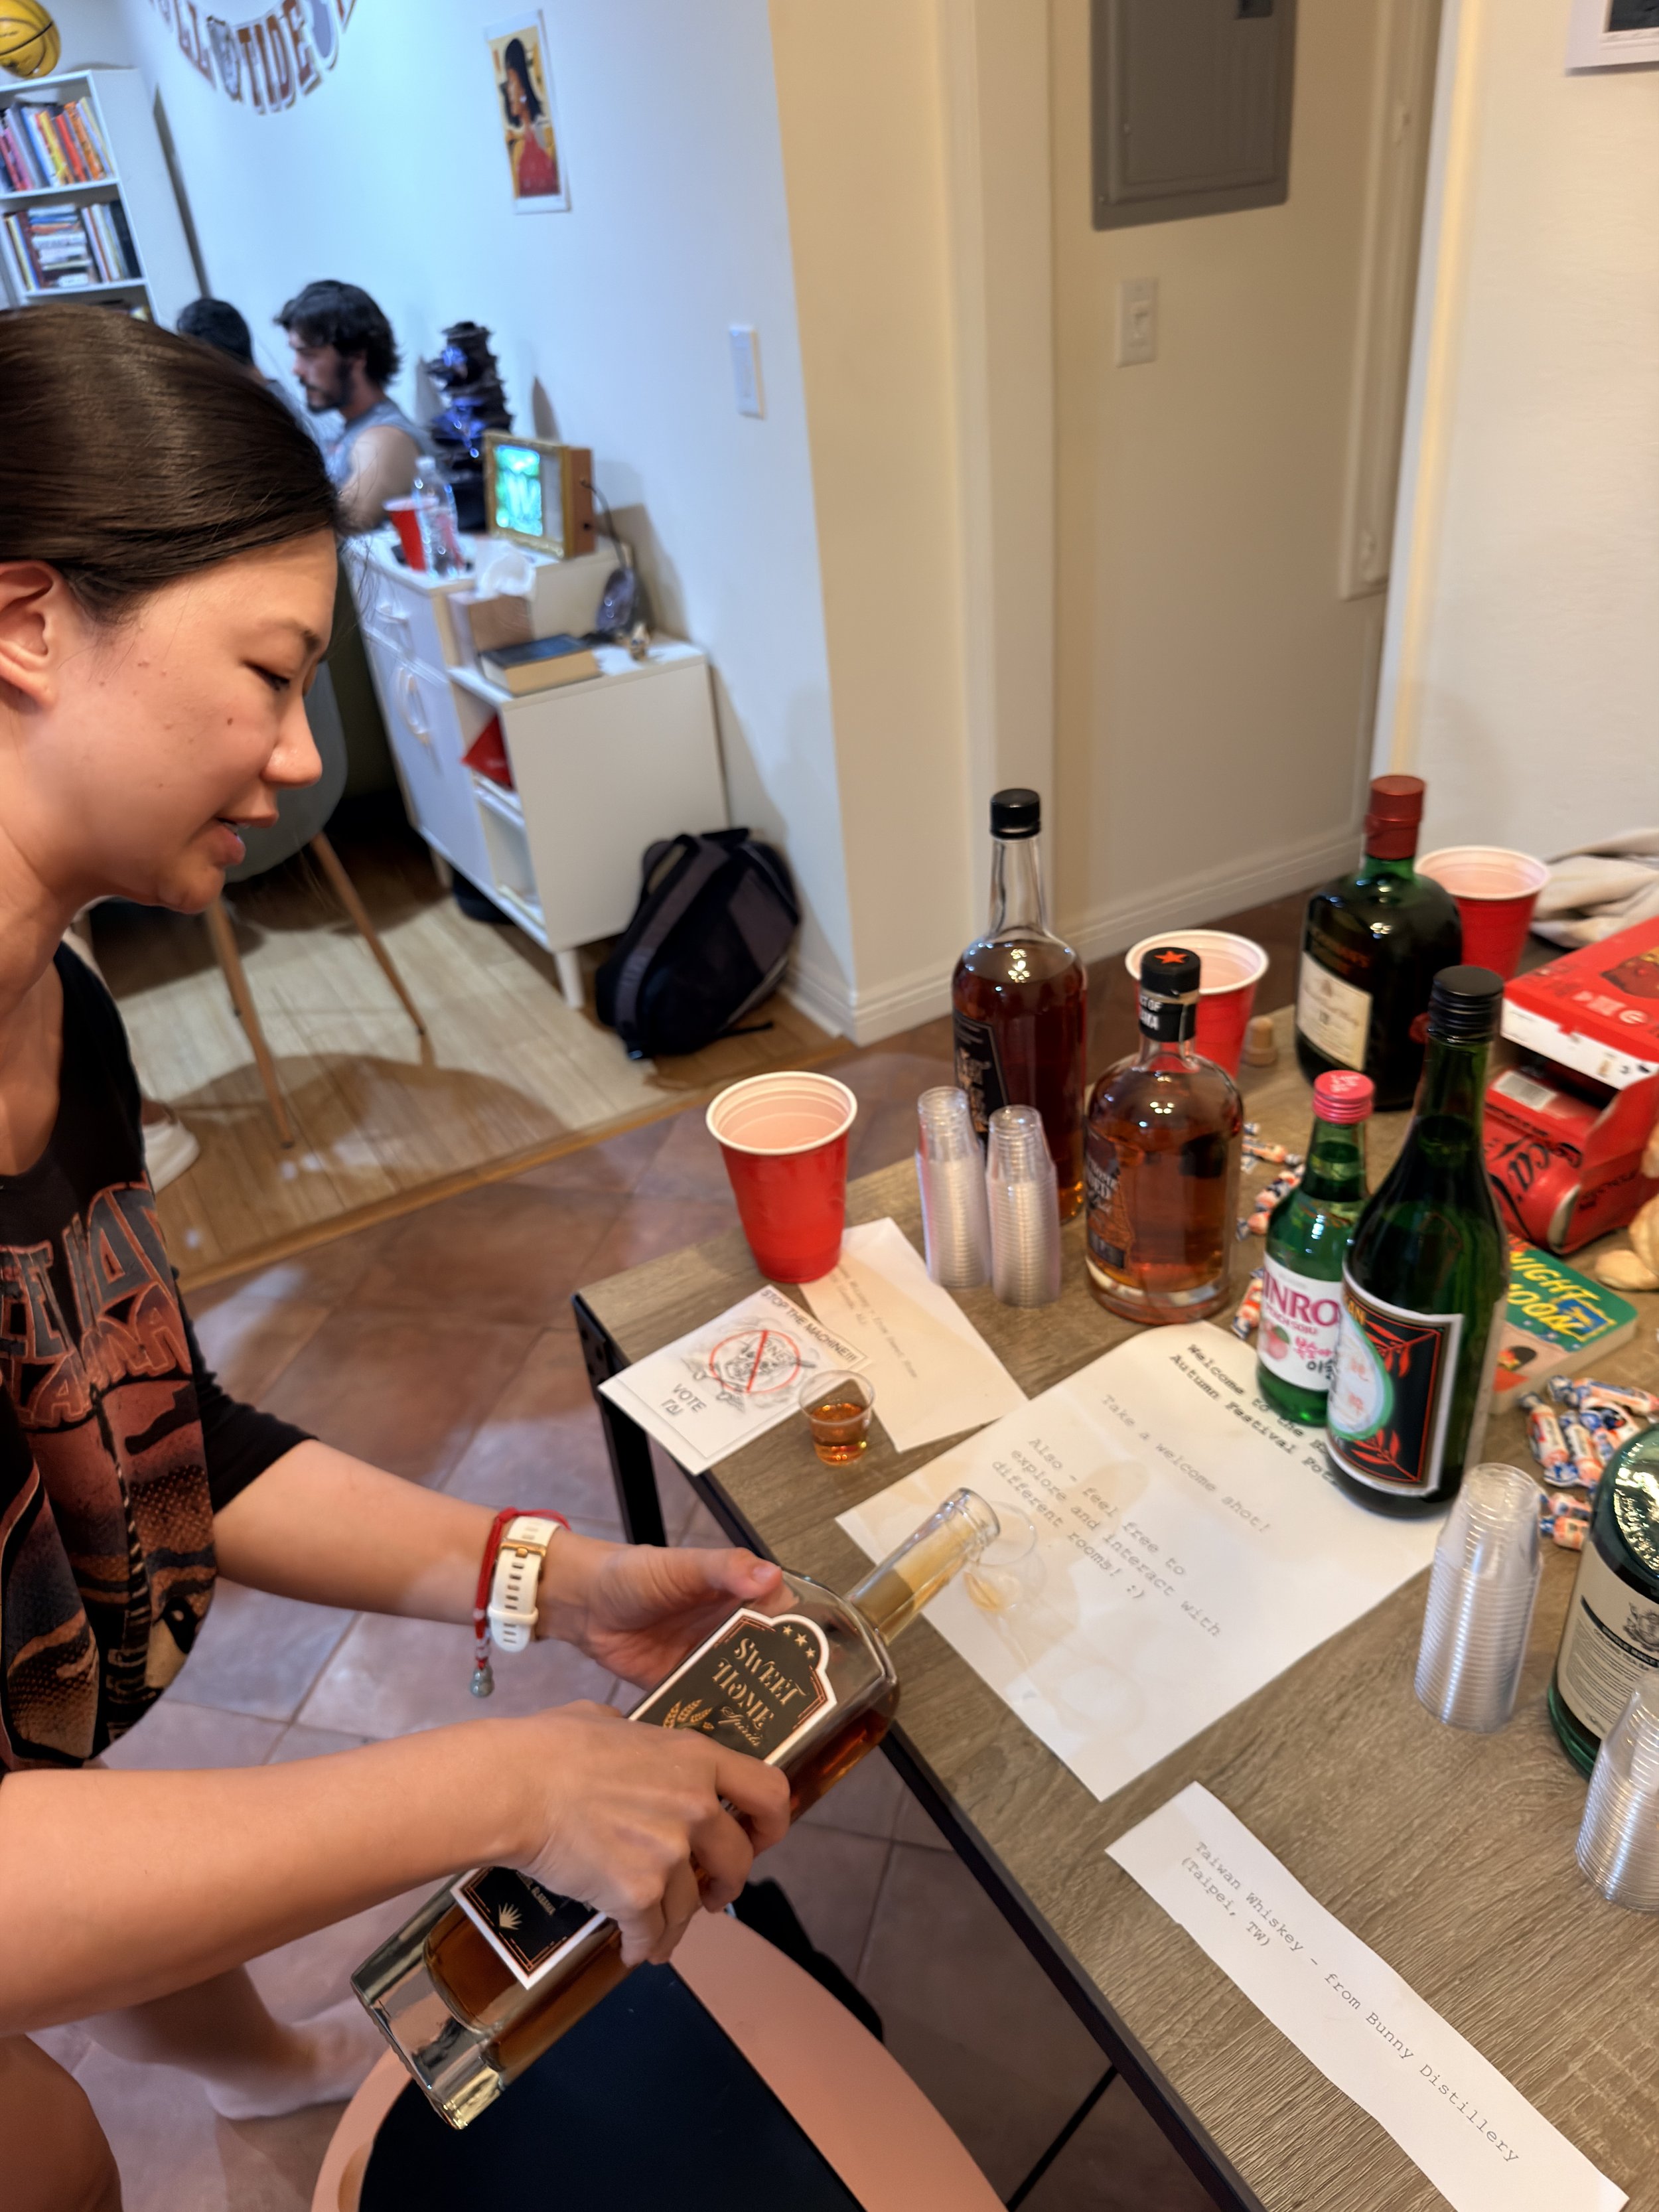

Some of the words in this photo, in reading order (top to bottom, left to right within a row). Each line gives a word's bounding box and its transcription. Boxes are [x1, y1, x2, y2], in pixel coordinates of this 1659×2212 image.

[236, 0, 315, 107] TIDE
[762, 1289, 788, 1308] STOP
[786, 1306, 809, 1325] THE
[805, 1322, 859, 1362] MACHINE!!!
[1262, 1268, 1340, 1327] INRO
[1506, 1284, 1585, 1329] OON
[673, 1383, 707, 1413] VOTE
[1170, 1353, 1220, 1400] Autumn
[1225, 1401, 1297, 1455] Festival
[1188, 1343, 1245, 1395] Welcome
[1252, 1397, 1271, 1412] to
[1277, 1416, 1305, 1439] the
[1029, 1436, 1063, 1471] Also
[1082, 1485, 1119, 1518] feel
[1123, 1520, 1160, 1554] free
[1165, 1558, 1187, 1577] to
[1102, 1395, 1137, 1428] Take
[1140, 1431, 1151, 1441] a
[1155, 1441, 1218, 1493] welcome
[1220, 1495, 1271, 1534] shot!
[991, 1459, 1064, 1528] different
[1067, 1530, 1124, 1579] rooms!
[1010, 1449, 1067, 1503] explore
[1070, 1504, 1100, 1532] and
[1103, 1532, 1177, 1597] interact
[1180, 1598, 1222, 1638] with
[711, 1657, 775, 1730] HOME
[734, 1637, 806, 1706] SWEET
[717, 1706, 763, 1747] Spirits
[1181, 1856, 1238, 1918] (Taipei,
[1244, 1920, 1271, 1948] TW)
[1194, 1841, 1244, 1891] Taiwan
[1245, 1891, 1305, 1954] Whiskey
[1323, 1970, 1362, 2011] from
[1364, 2011, 1415, 2061] Bunny
[1419, 2061, 1520, 2164] Distillery
